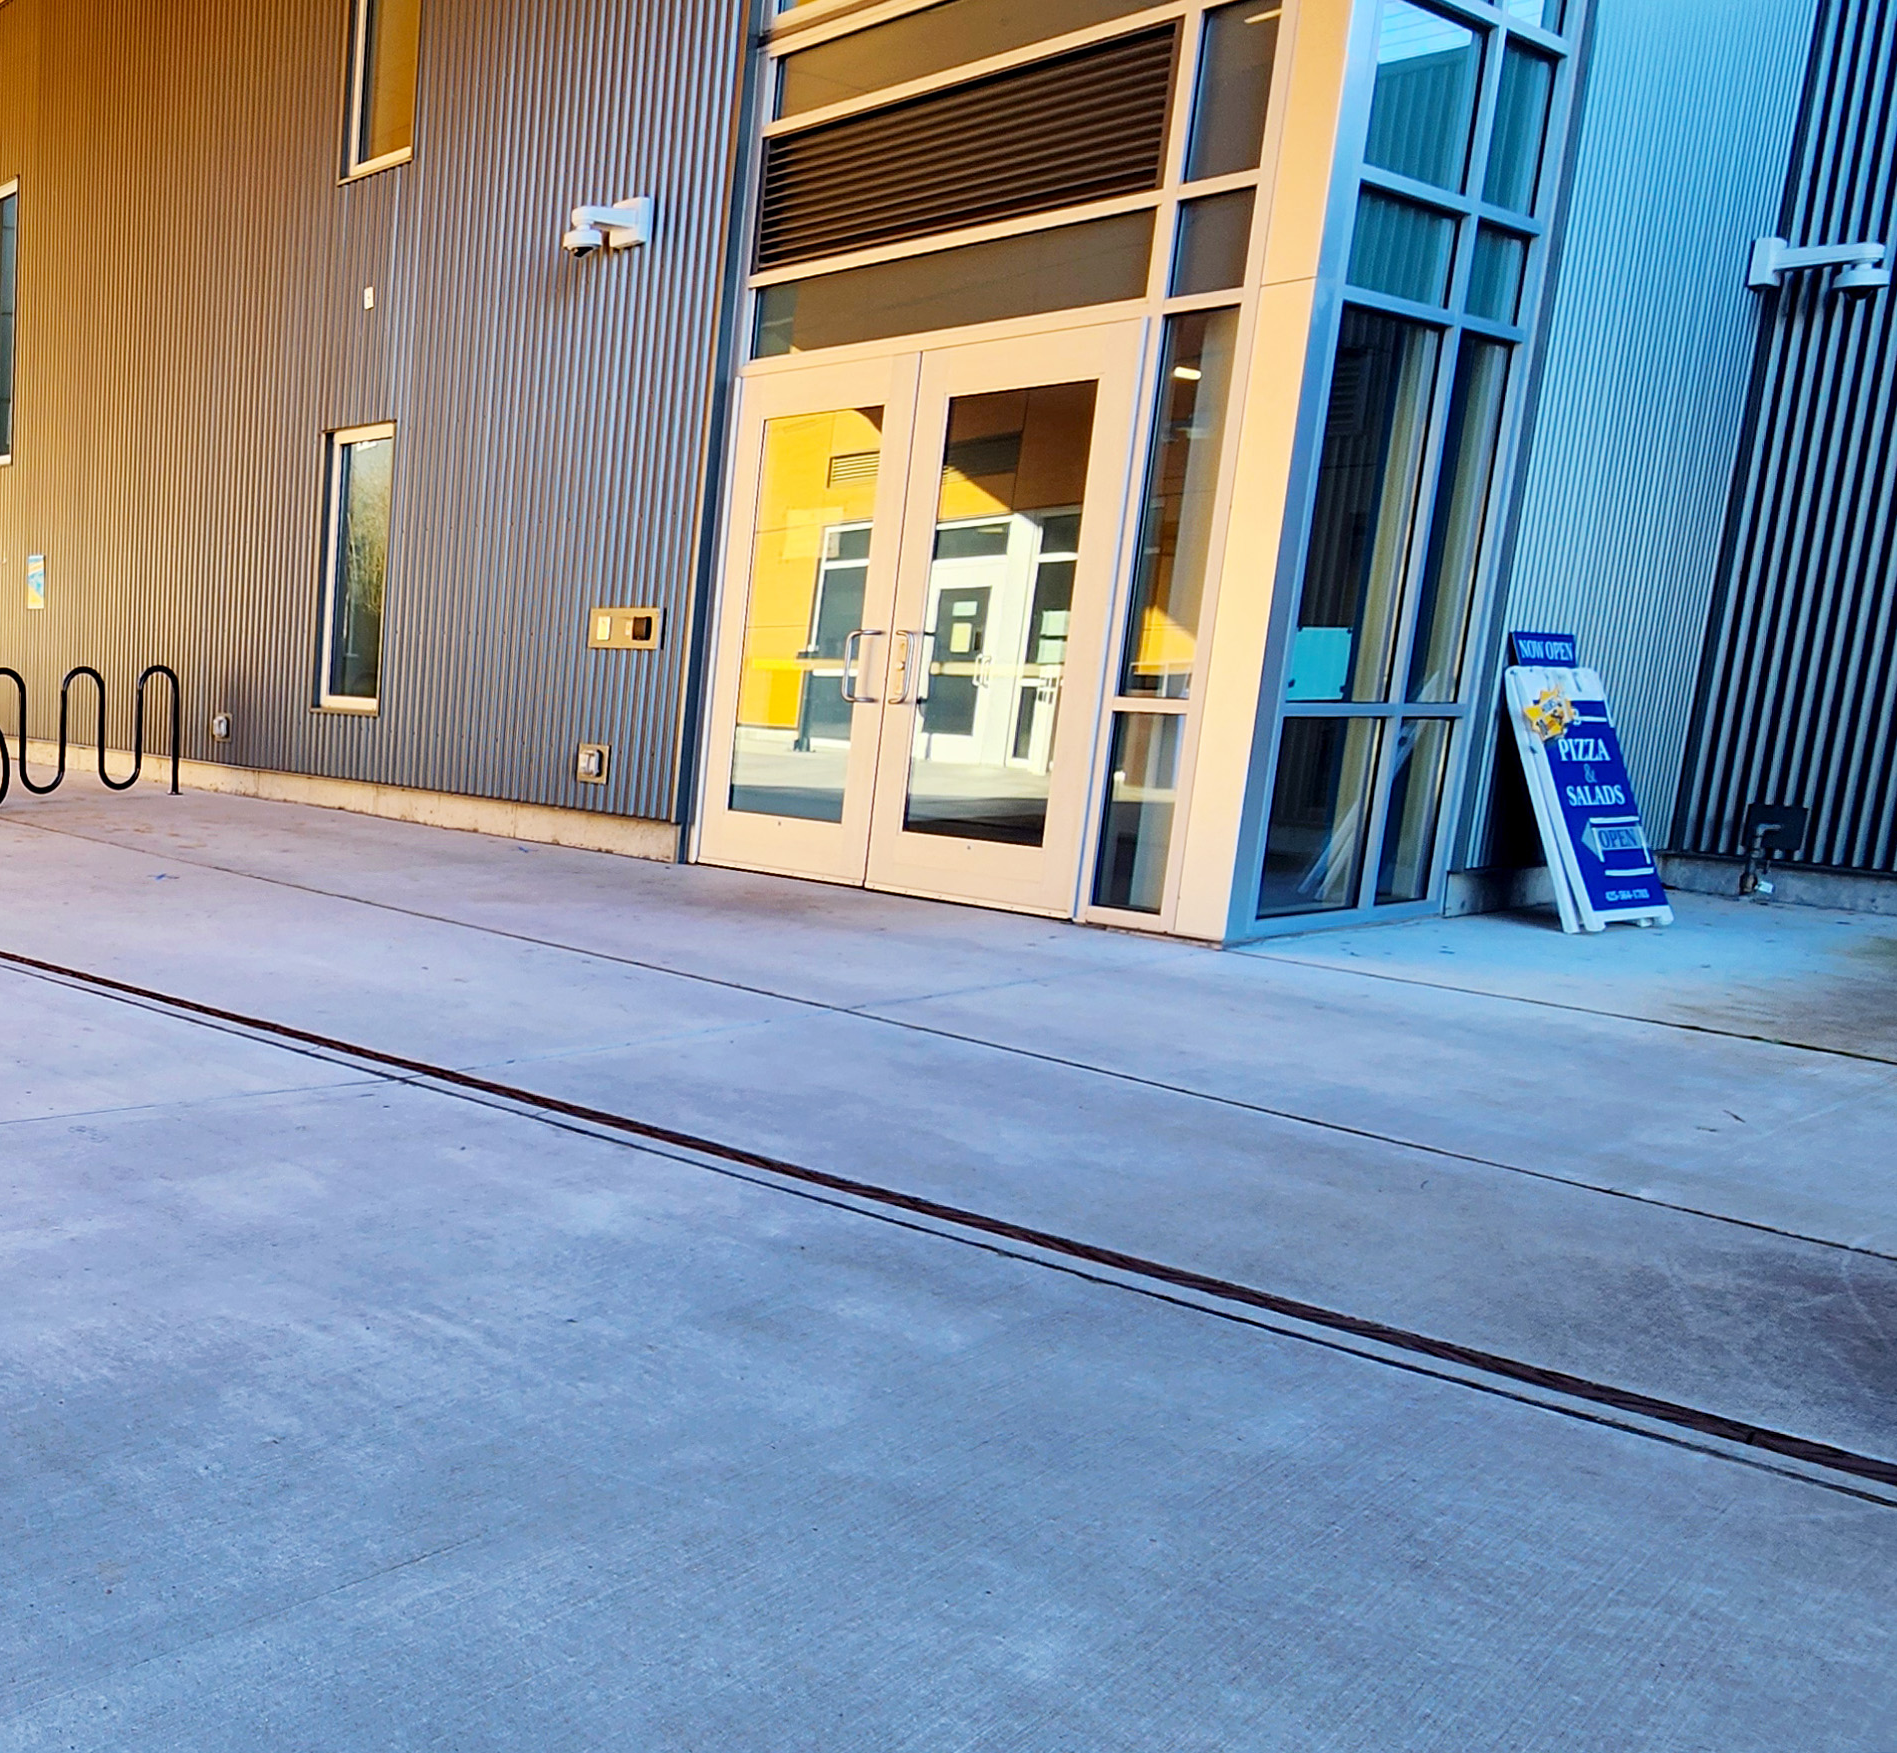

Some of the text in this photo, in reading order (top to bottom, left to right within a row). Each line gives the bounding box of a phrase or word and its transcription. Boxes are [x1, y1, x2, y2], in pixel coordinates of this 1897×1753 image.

[1518, 639, 1573, 661] NOW OPEN
[1558, 738, 1611, 762] PIZZA
[1583, 763, 1598, 784] &
[1566, 784, 1626, 807] SALADS
[1598, 829, 1638, 849] OPEN
